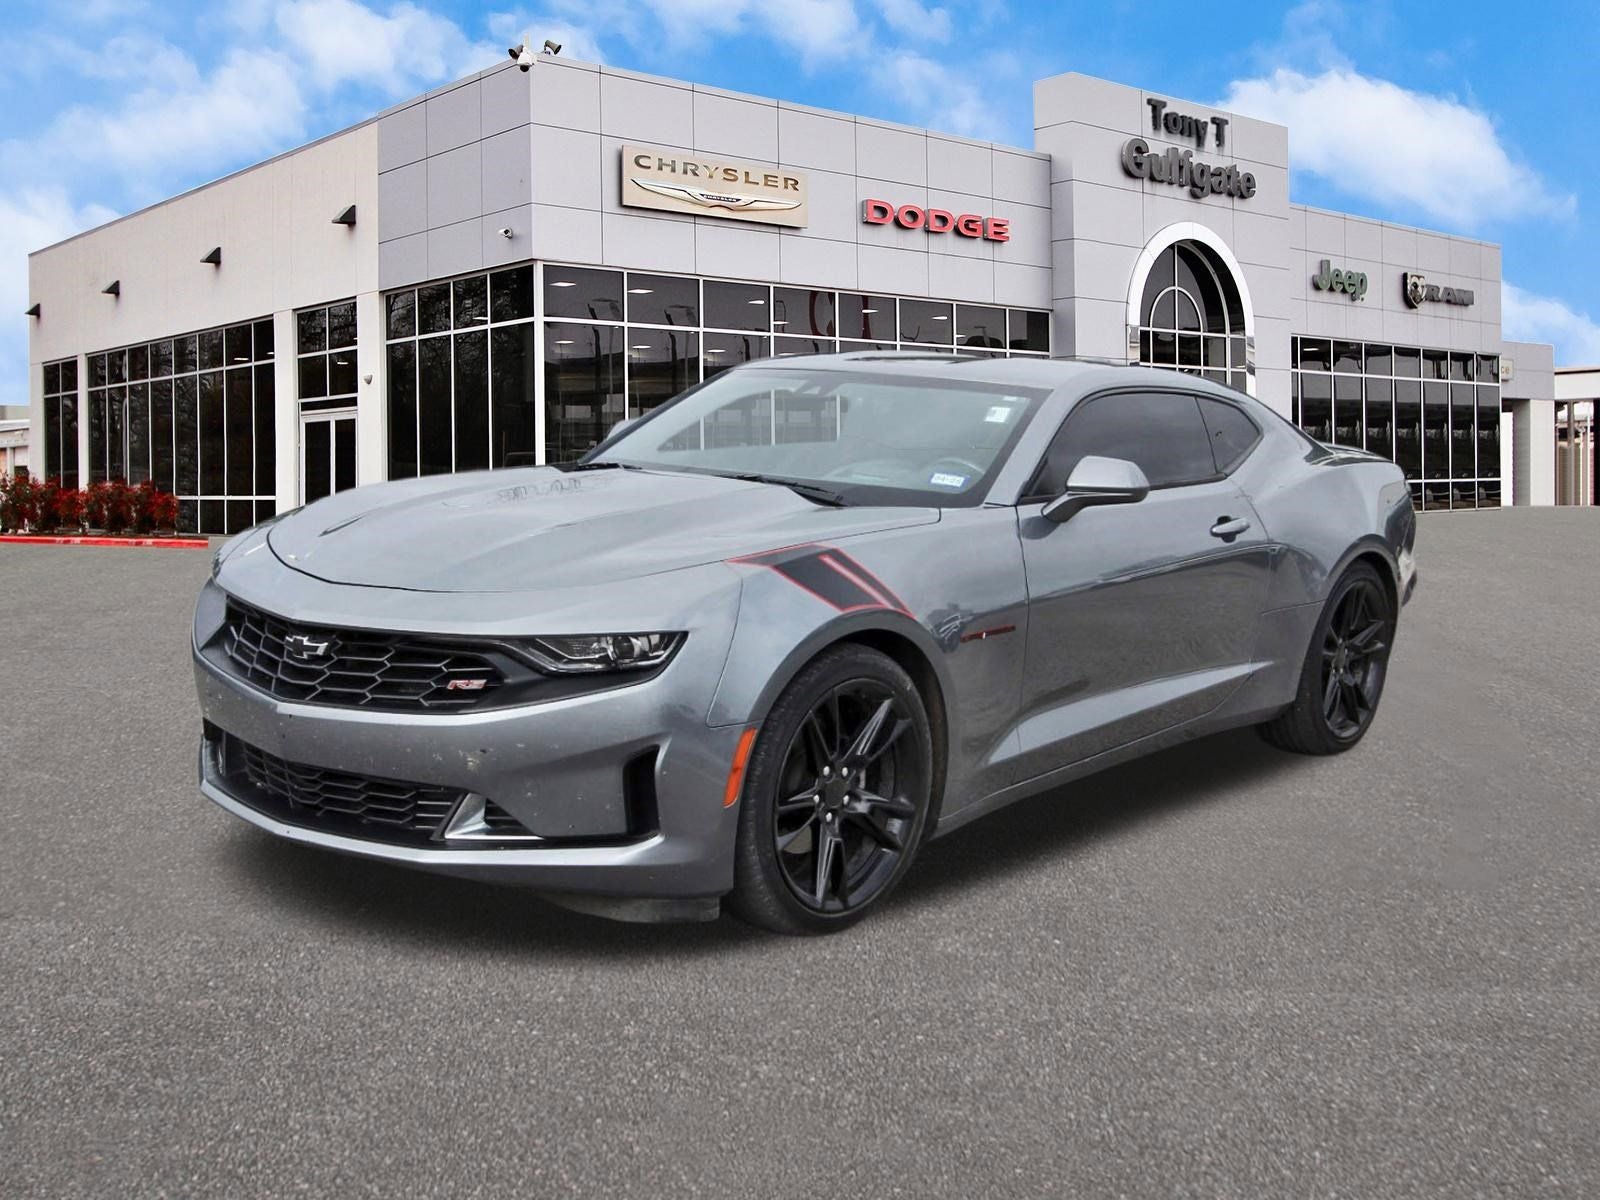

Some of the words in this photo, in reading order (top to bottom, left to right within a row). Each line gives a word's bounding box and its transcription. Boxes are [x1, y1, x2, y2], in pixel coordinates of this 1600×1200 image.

[1147, 98, 1208, 147] Tony
[1211, 116, 1229, 147] T
[633, 154, 800, 192] CHRYSLER
[1121, 138, 1256, 199] Gulfgate
[863, 198, 1011, 243] DODGE
[1312, 259, 1368, 301] Jeep
[1425, 284, 1475, 306] RAM
[447, 679, 487, 690] RS
